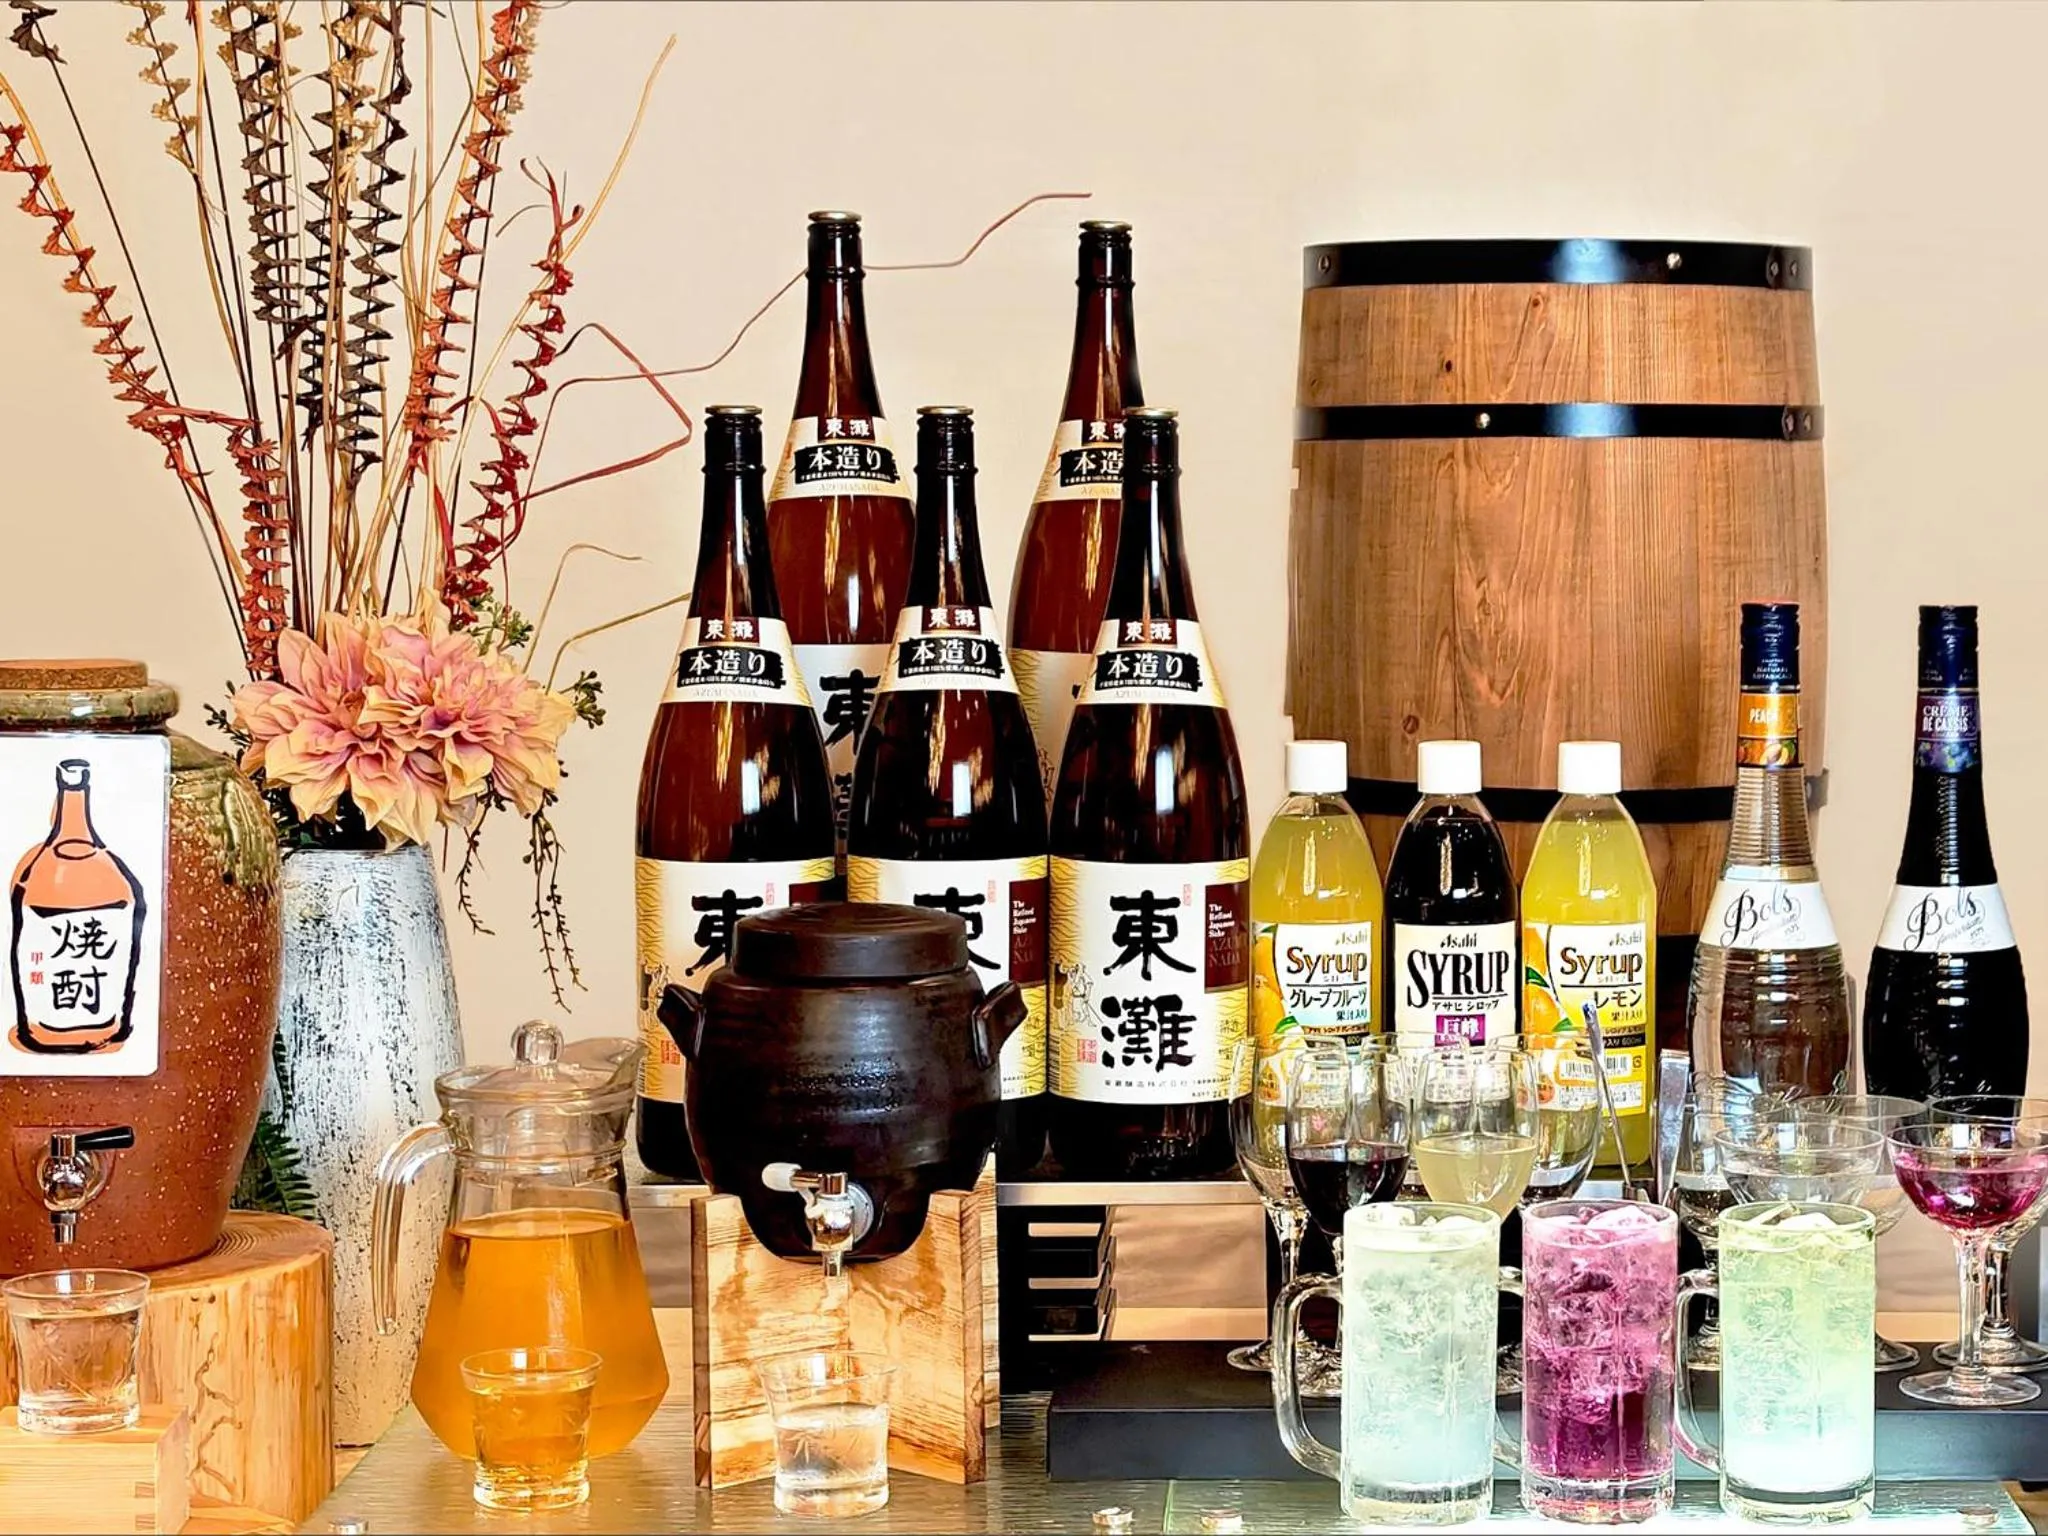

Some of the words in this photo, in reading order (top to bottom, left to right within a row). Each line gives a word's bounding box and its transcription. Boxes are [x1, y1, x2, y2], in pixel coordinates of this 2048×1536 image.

[809, 446, 881, 471] 本造り
[1074, 450, 1124, 475] 本造
[689, 649, 766, 675] 本造り
[911, 639, 987, 665] 本造り
[1107, 653, 1183, 679] 本造り
[1923, 716, 1932, 731] DE
[1935, 716, 1969, 732] CASSIS
[1720, 884, 1792, 948] Bols
[1903, 886, 1977, 951] Bols
[1334, 929, 1368, 946] Asahi
[1440, 932, 1478, 949] Asahi
[1609, 928, 1643, 946] Asahi
[50, 916, 118, 1015] 焼酎
[1286, 946, 1368, 983] Syrup
[1560, 946, 1643, 984] Syrup
[1406, 949, 1510, 1009] SYRUP
[1289, 987, 1368, 1008] グレープフルーツ
[1432, 1001, 1464, 1012] アサヒ
[1466, 1000, 1500, 1012] シロップ
[1593, 988, 1642, 1009] レモン
